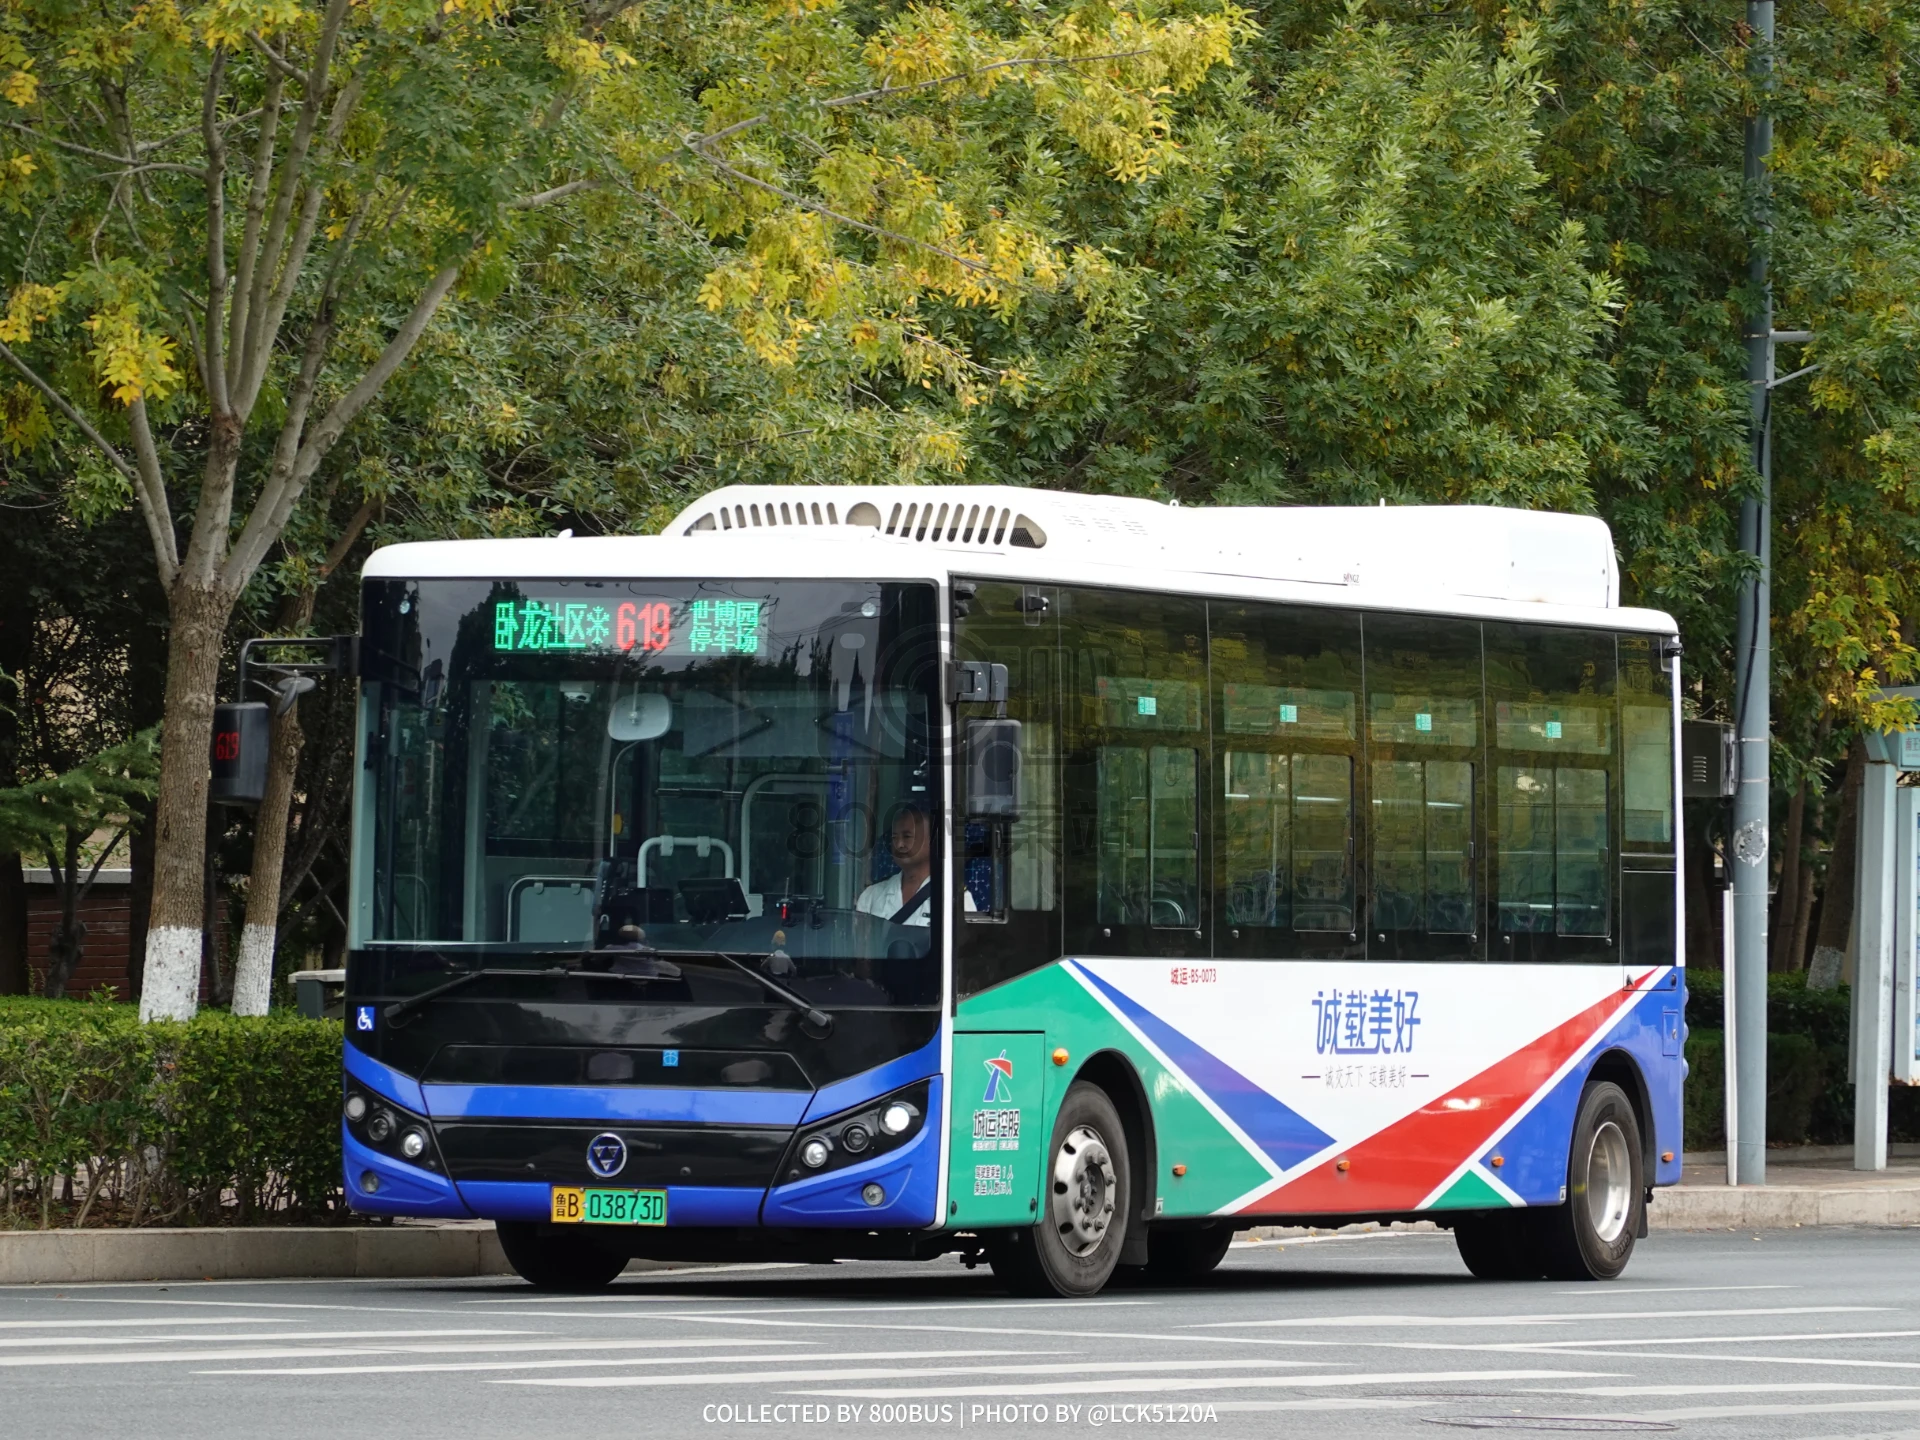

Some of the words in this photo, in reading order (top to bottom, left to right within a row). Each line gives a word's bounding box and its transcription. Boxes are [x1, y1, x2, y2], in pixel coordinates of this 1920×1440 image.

[495, 601, 587, 650] 卧龙社区
[616, 602, 671, 650] 619
[690, 600, 759, 628] 世博园
[689, 627, 758, 653] 停车场
[215, 731, 239, 760] 619
[1312, 988, 1421, 1055] 诚载美好
[973, 1109, 1020, 1139] 城运控股
